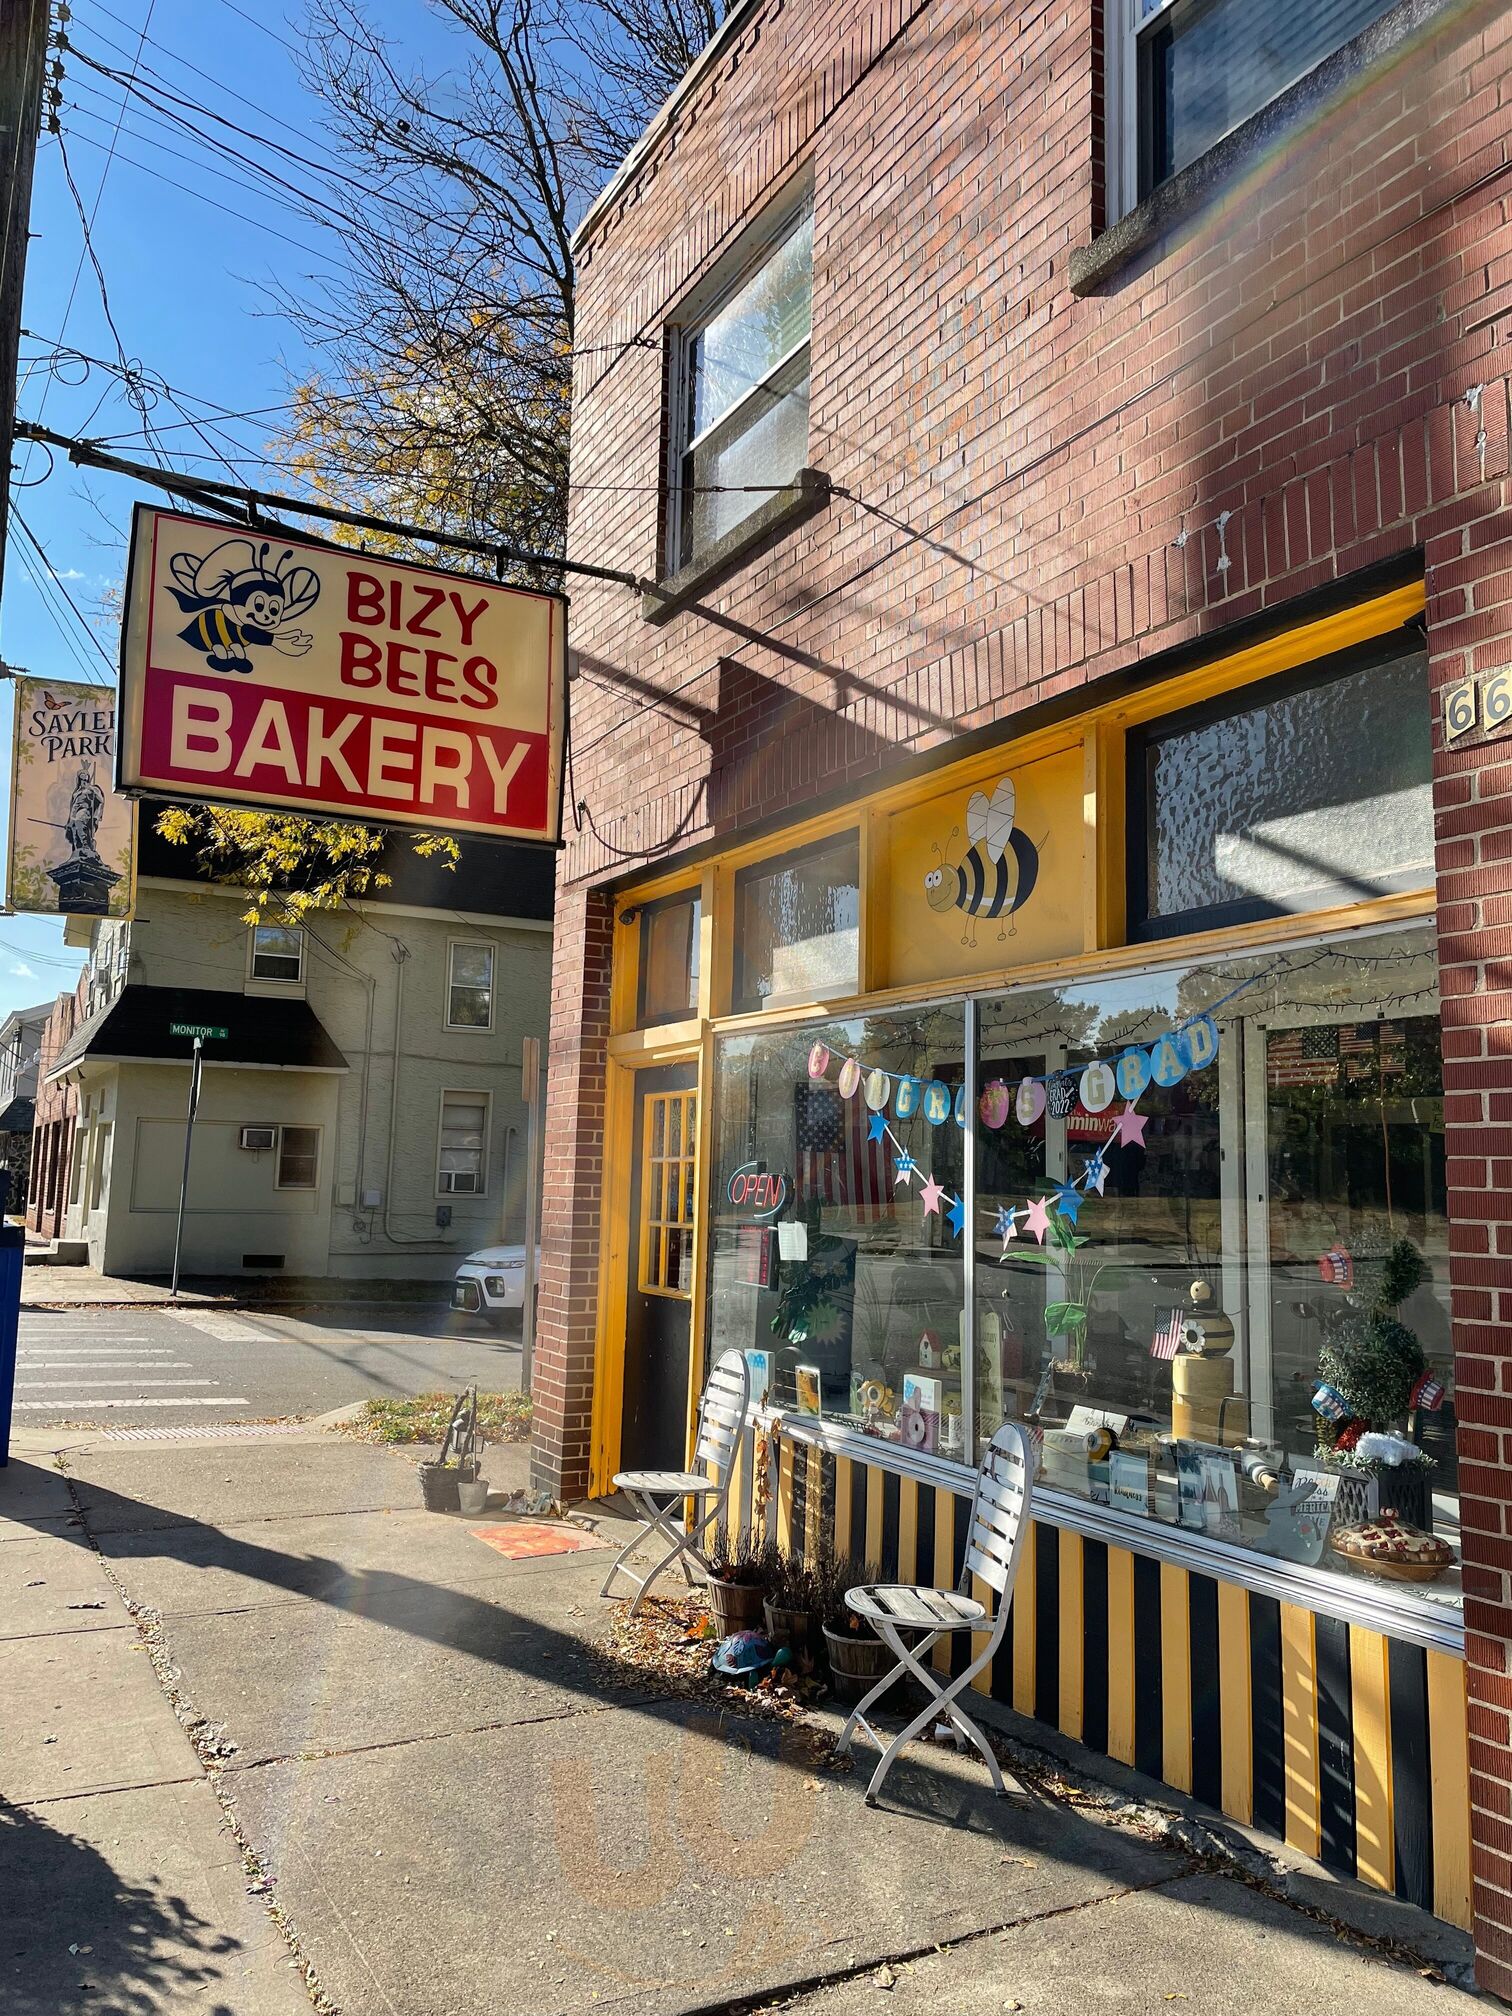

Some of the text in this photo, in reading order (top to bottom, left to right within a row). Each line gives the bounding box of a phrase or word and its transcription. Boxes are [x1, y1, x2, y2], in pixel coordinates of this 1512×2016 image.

[347, 571, 489, 646] BIZY
[339, 631, 499, 710] BEES
[40, 735, 112, 763] PARK
[169, 684, 531, 815] BAKERY
[172, 1024, 213, 1037] MONITOR
[1087, 1020, 1217, 1106] GRAD
[1049, 1086, 1067, 1102] GRAD
[1051, 1098, 1070, 1116] 2022
[732, 1173, 782, 1208] OPEN
